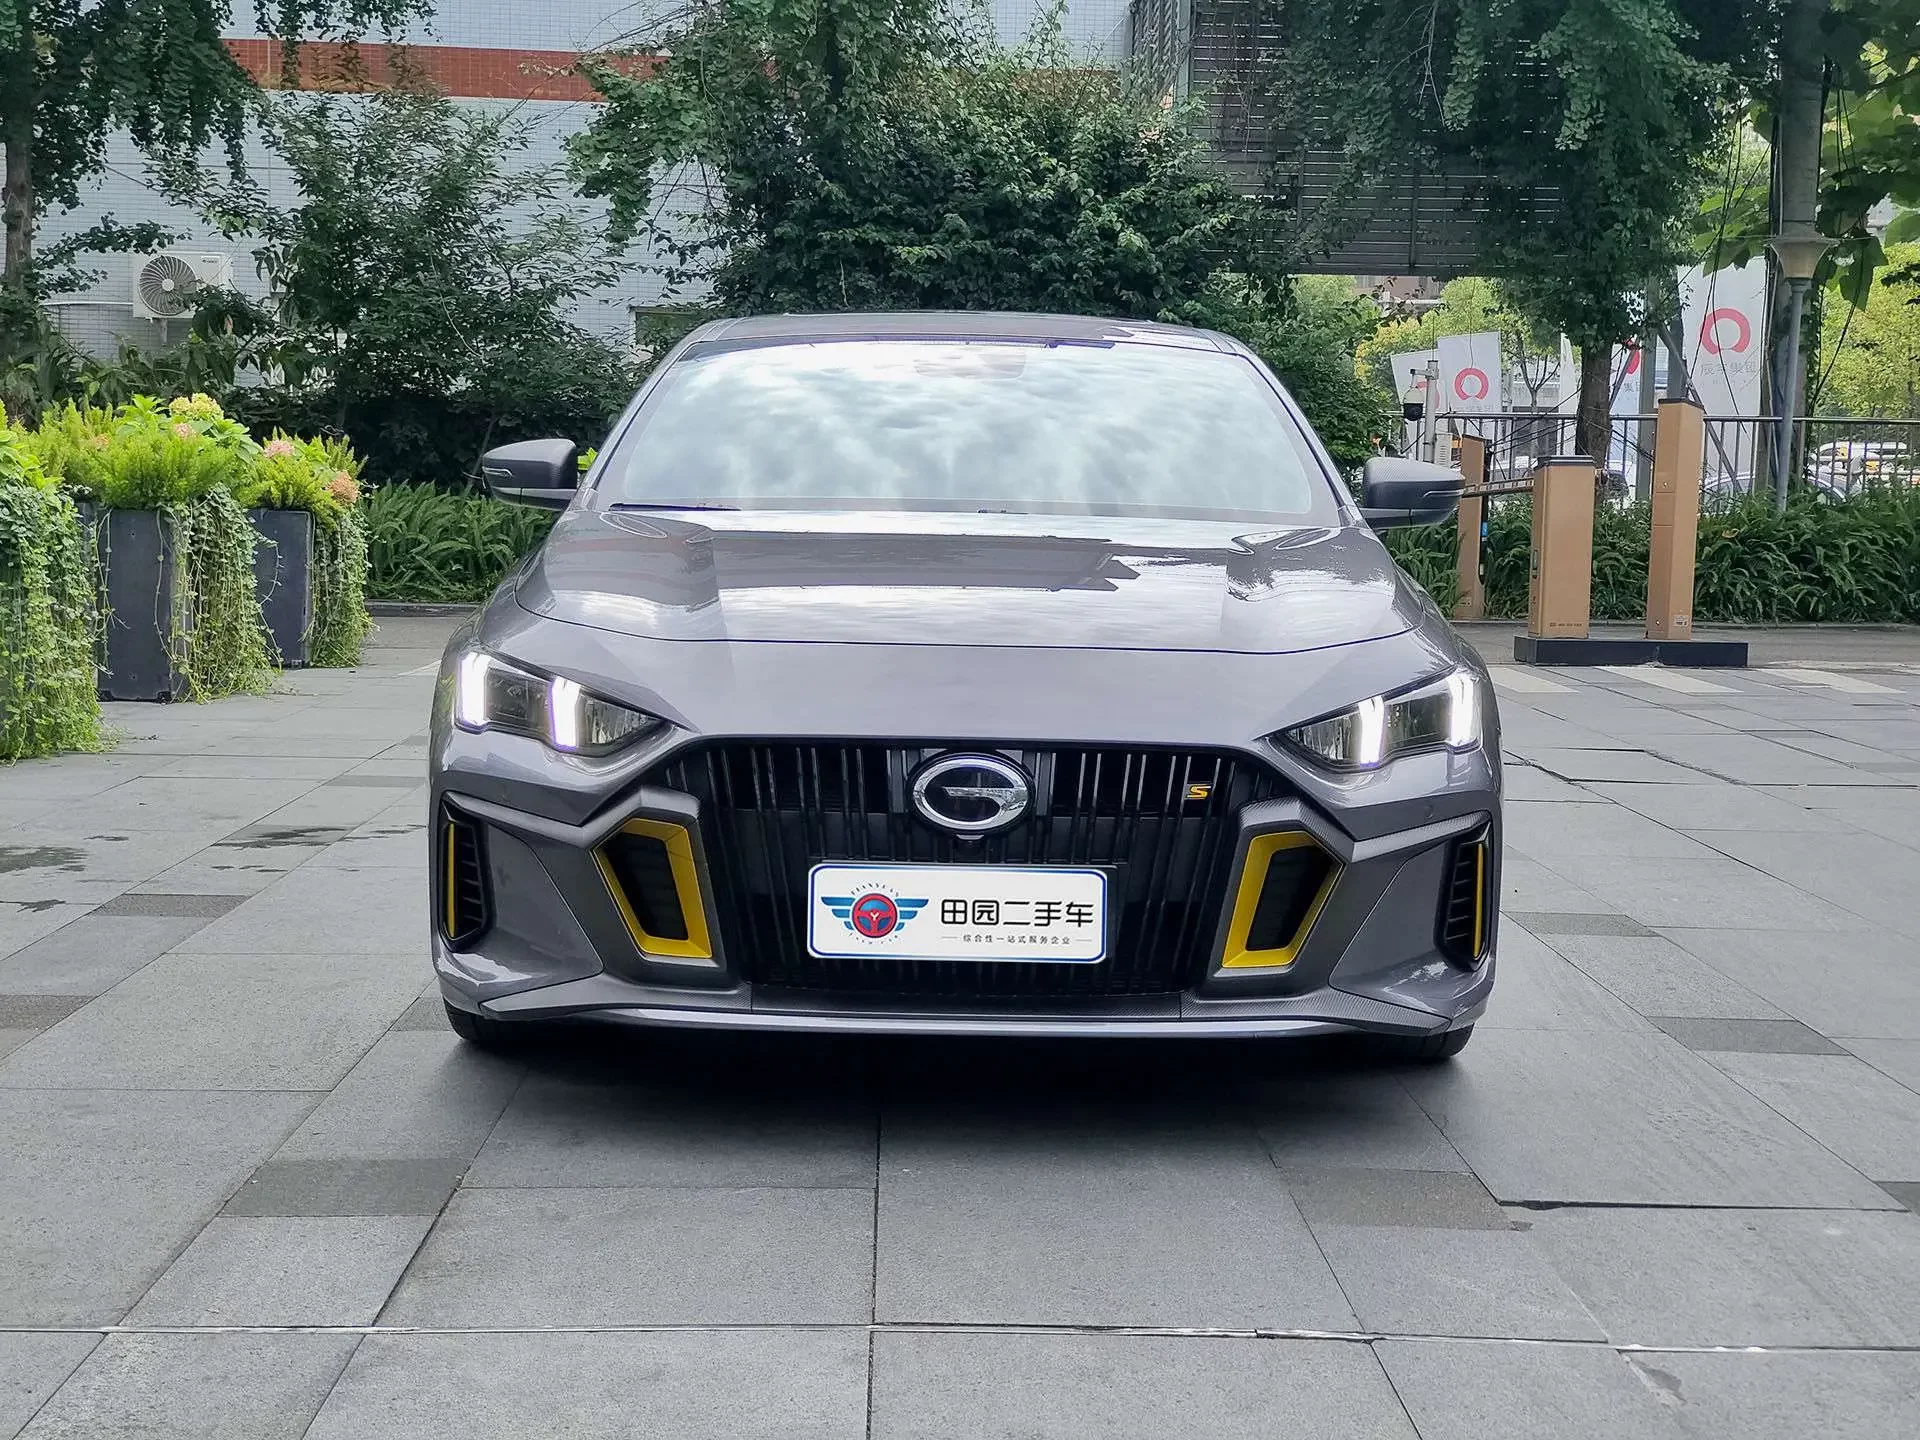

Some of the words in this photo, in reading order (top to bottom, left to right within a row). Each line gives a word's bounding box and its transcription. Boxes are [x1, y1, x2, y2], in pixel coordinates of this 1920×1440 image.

[1187, 785, 1212, 798] S
[941, 899, 1094, 928] 田园二手车
[963, 934, 1071, 945] 综合性一站式服务企业
